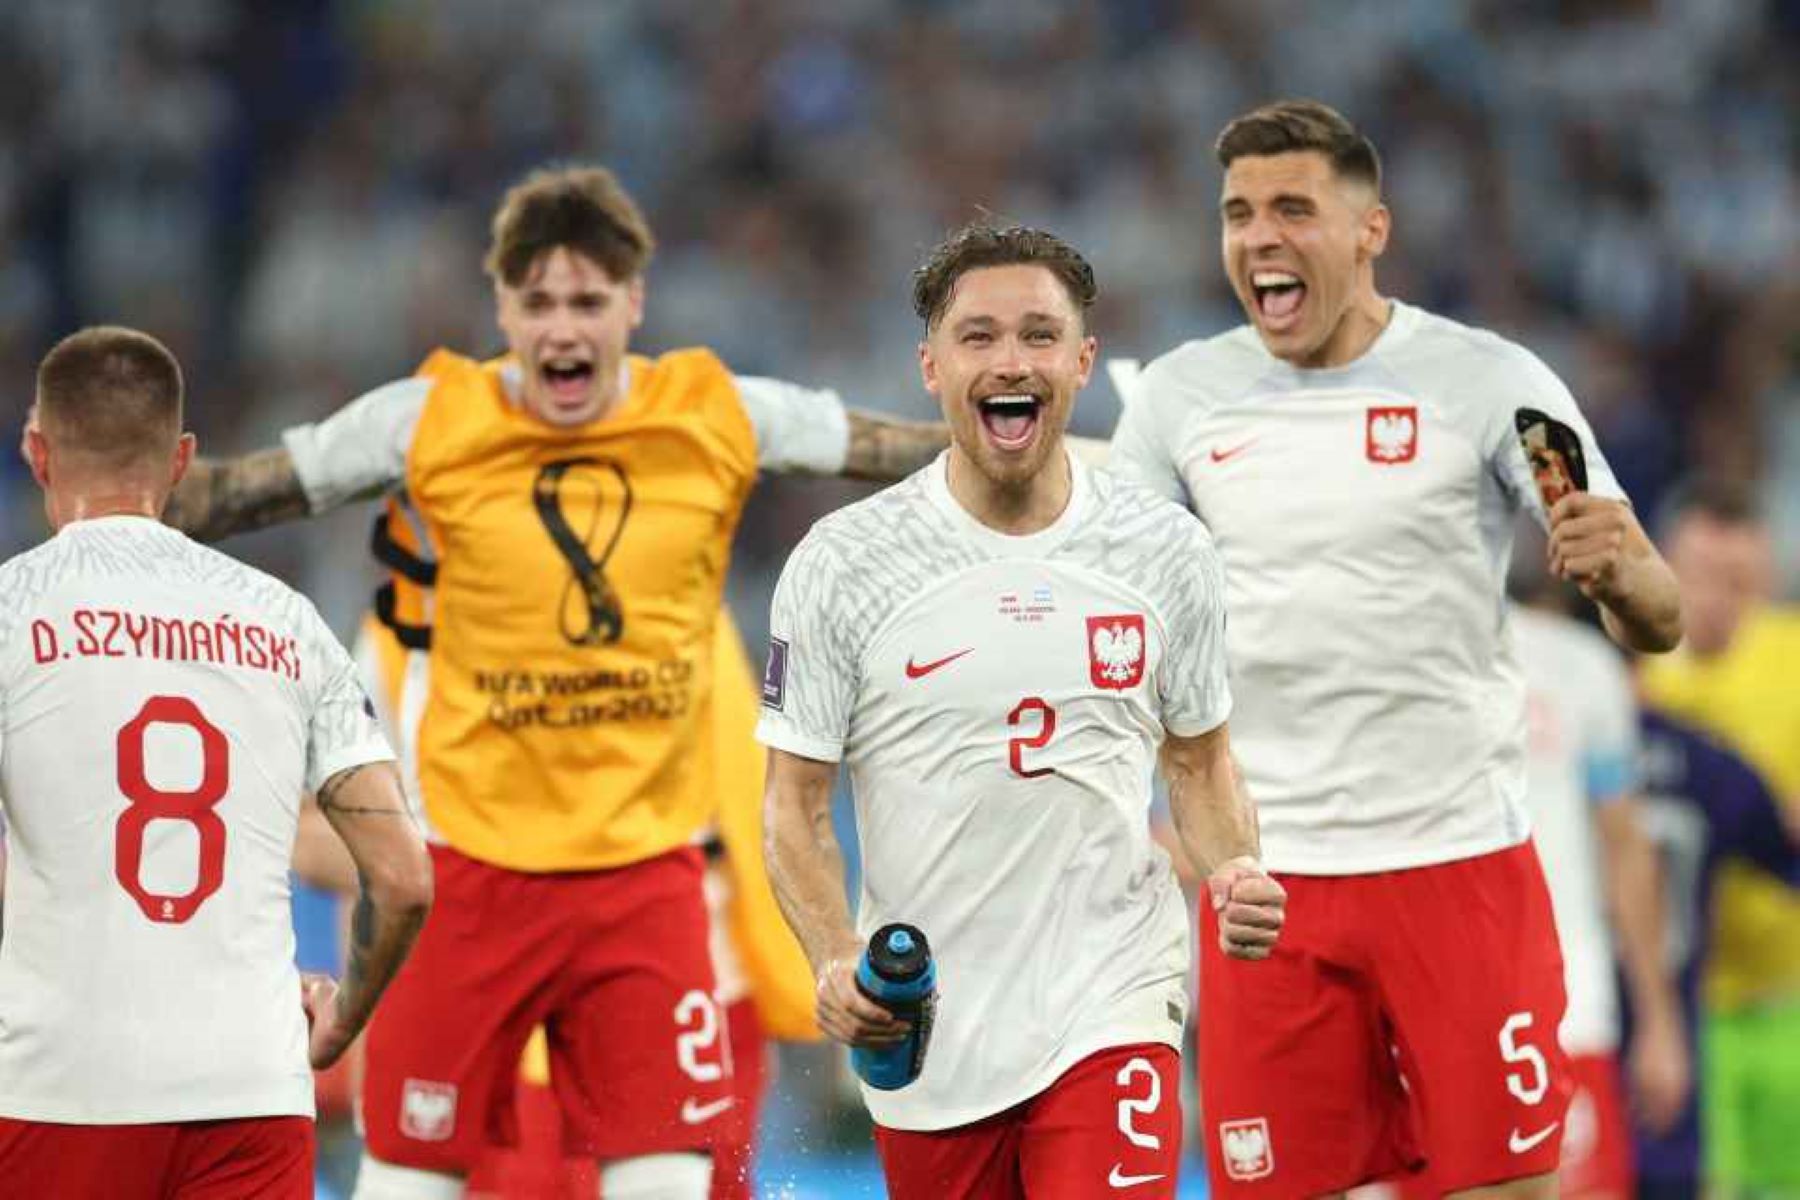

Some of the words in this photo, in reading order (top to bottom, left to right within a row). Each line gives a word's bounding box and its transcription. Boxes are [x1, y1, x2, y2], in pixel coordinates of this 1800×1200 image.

[1007, 697, 1056, 779] 2
[115, 695, 229, 923] 8
[1116, 1058, 1161, 1149] 2
[1499, 1011, 1549, 1106] 5
